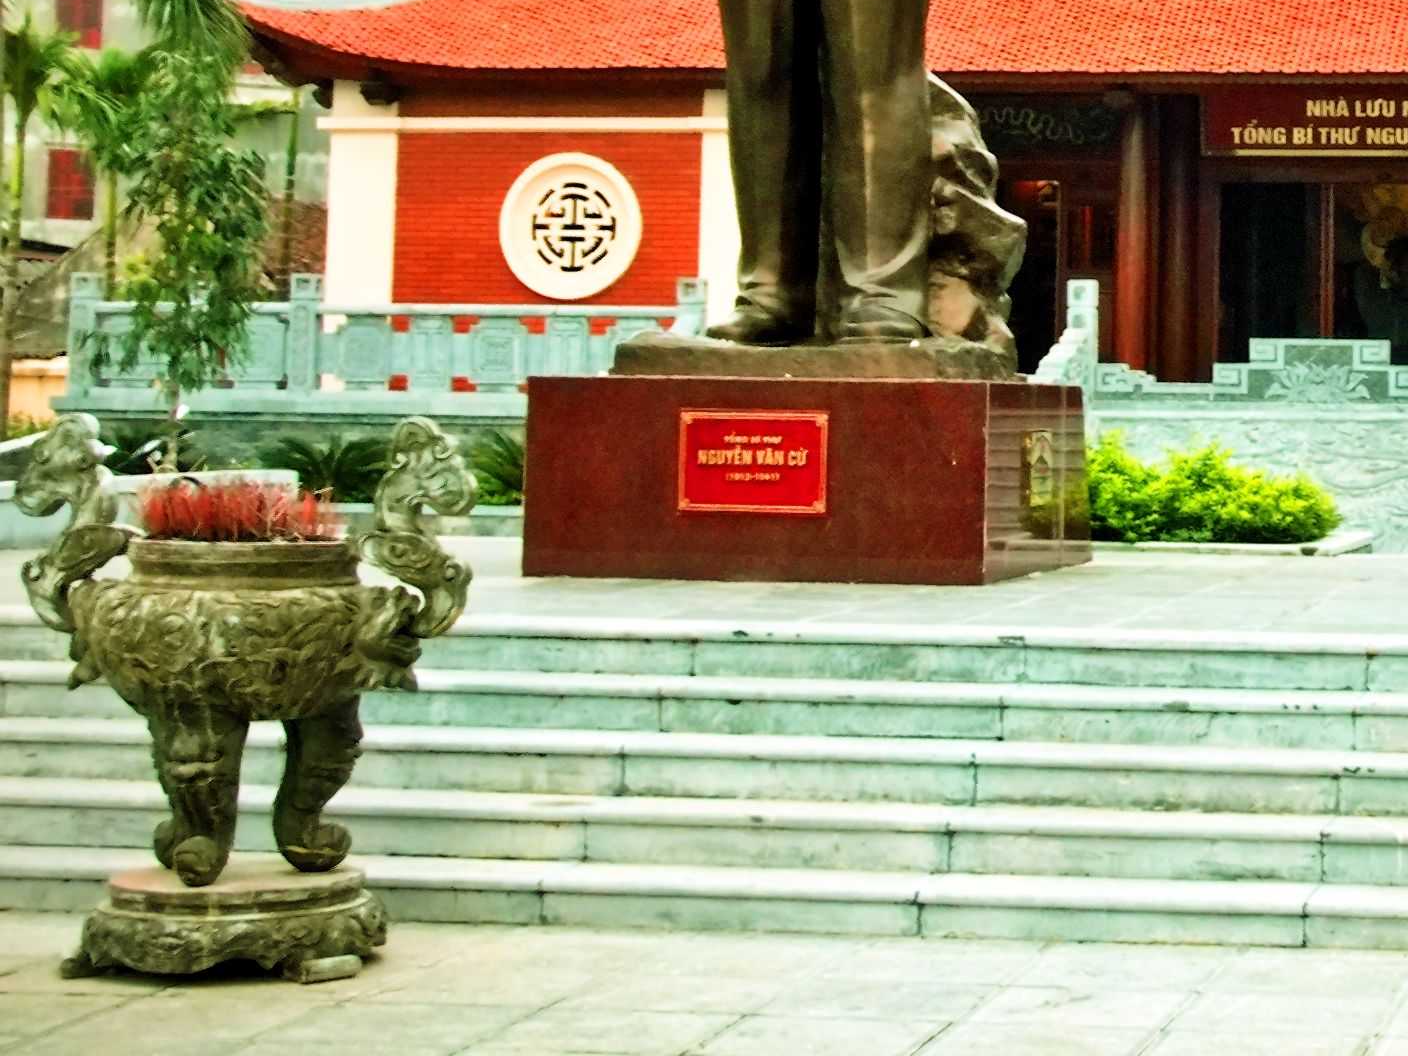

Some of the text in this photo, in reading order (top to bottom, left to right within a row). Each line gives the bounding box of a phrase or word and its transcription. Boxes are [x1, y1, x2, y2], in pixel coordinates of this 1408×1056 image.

[1305, 96, 1349, 117] NHÀ
[1355, 98, 1396, 117] LƯU
[1231, 119, 1287, 145] TỔNG
[1293, 124, 1314, 145] BÍ
[1318, 125, 1361, 145] THƯ
[697, 445, 753, 465] NGUYỄN
[756, 448, 785, 465] VĂN
